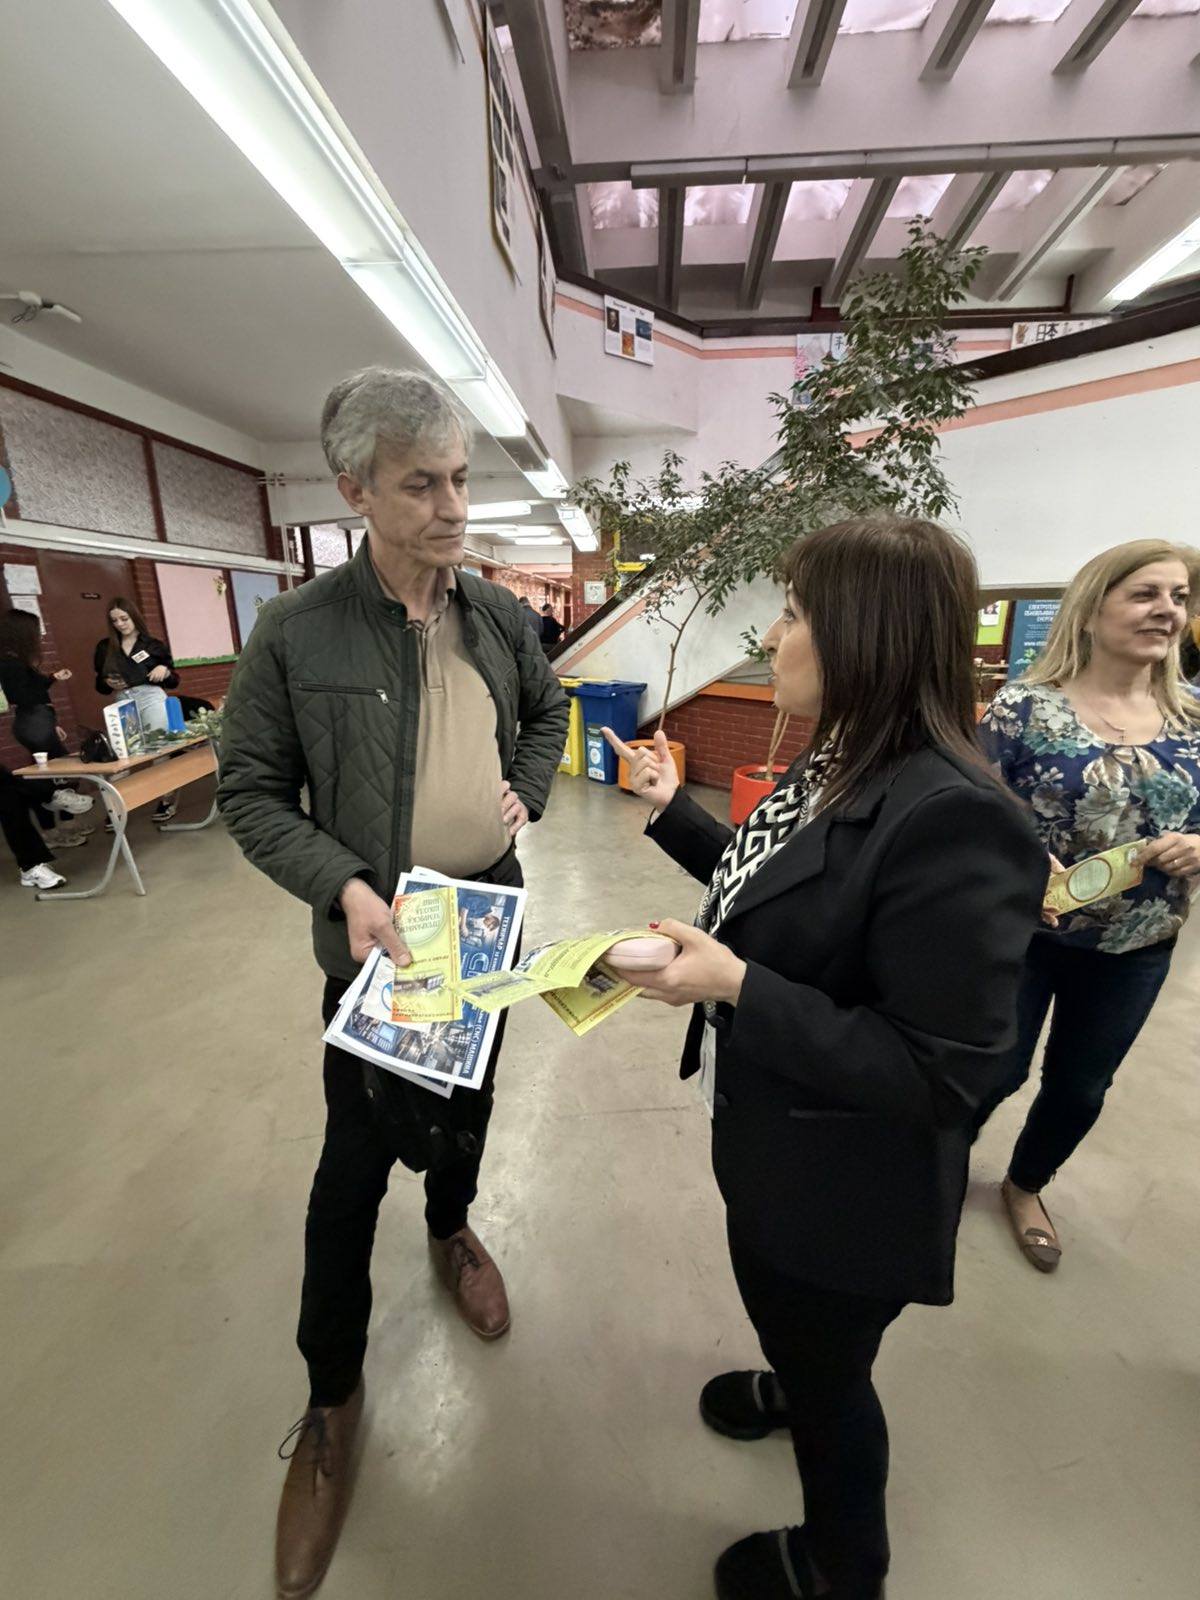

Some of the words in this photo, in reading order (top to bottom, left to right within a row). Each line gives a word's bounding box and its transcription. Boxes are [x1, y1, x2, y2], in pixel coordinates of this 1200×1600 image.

[497, 916, 511, 950] ТЕХНИЧАР
[471, 1024, 482, 1043] (CNC)
[462, 1043, 477, 1073] МАШИНА
